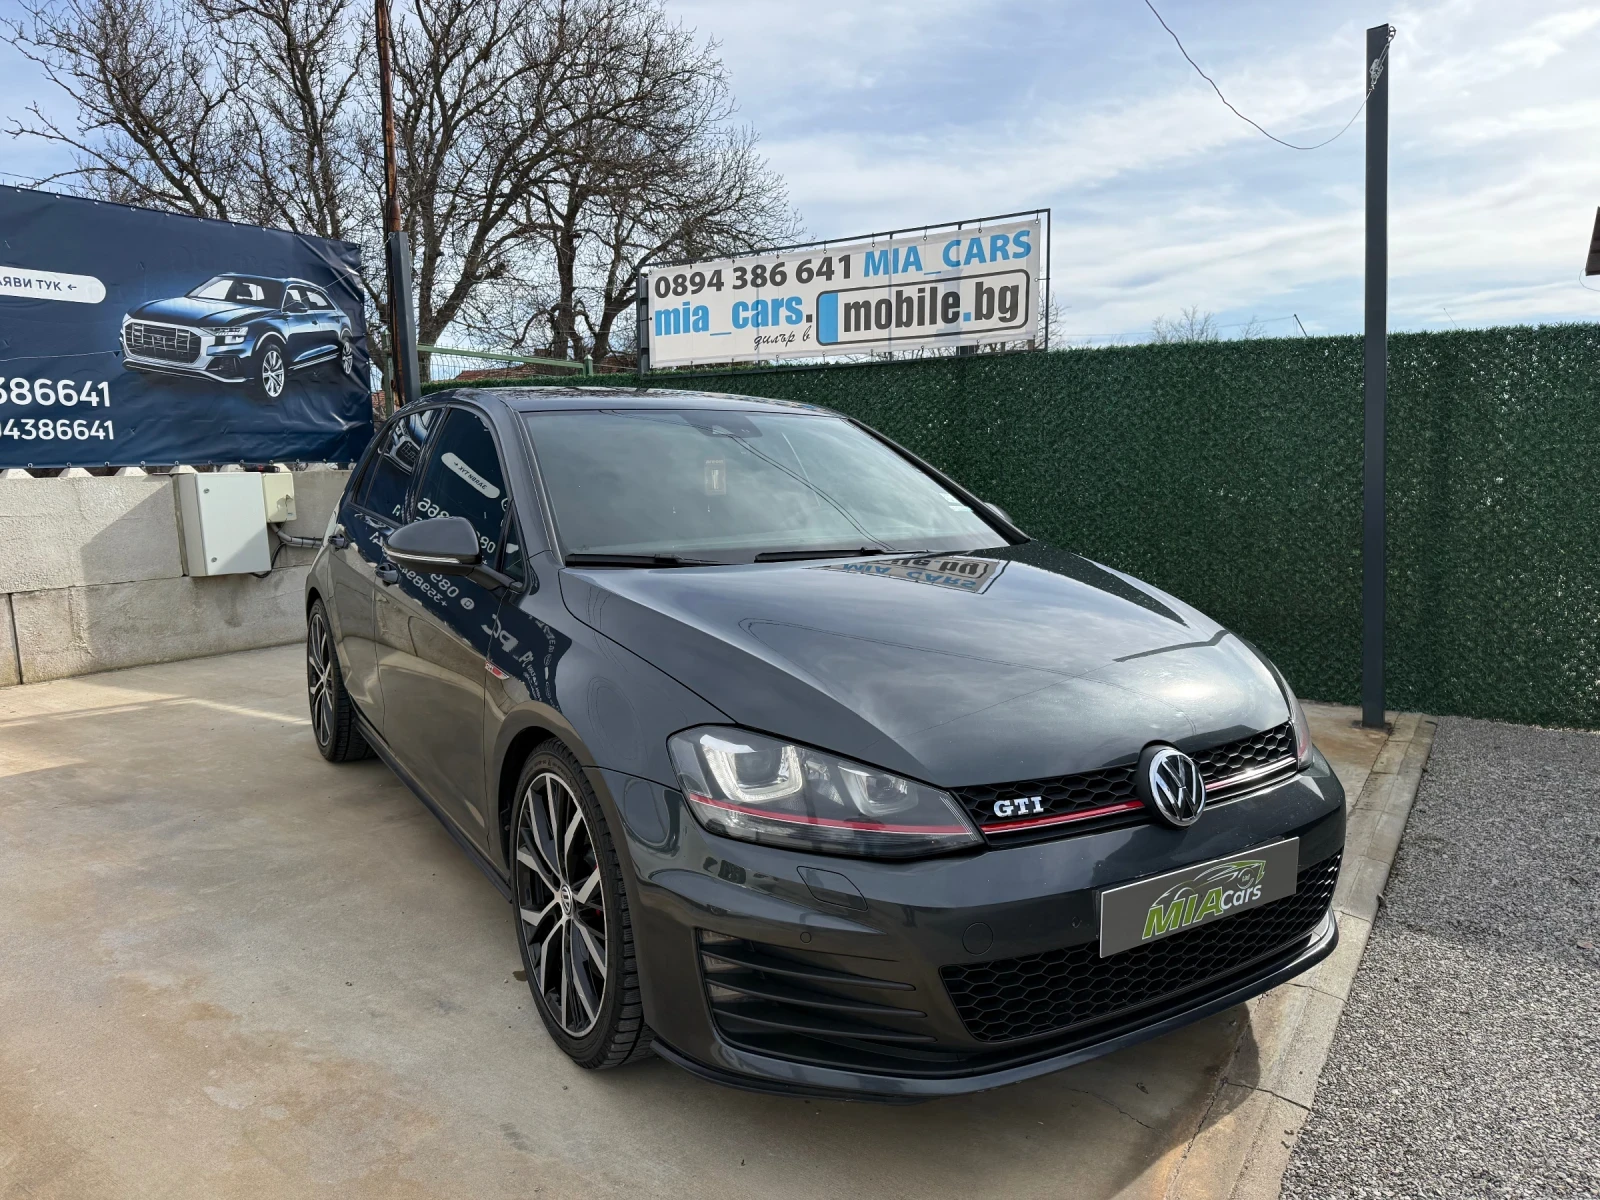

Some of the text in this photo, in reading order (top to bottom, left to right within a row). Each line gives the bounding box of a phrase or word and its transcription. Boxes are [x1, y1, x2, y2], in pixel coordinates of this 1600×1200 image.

[0, 276, 62, 291] ЯВИ ТУК
[654, 269, 725, 298] 0894
[732, 261, 788, 290] 386
[795, 254, 851, 285] 641
[843, 281, 1020, 333] mobile.bg
[753, 330, 796, 350] дилър
[0, 418, 114, 440] 4386641
[993, 796, 1044, 818] GTI
